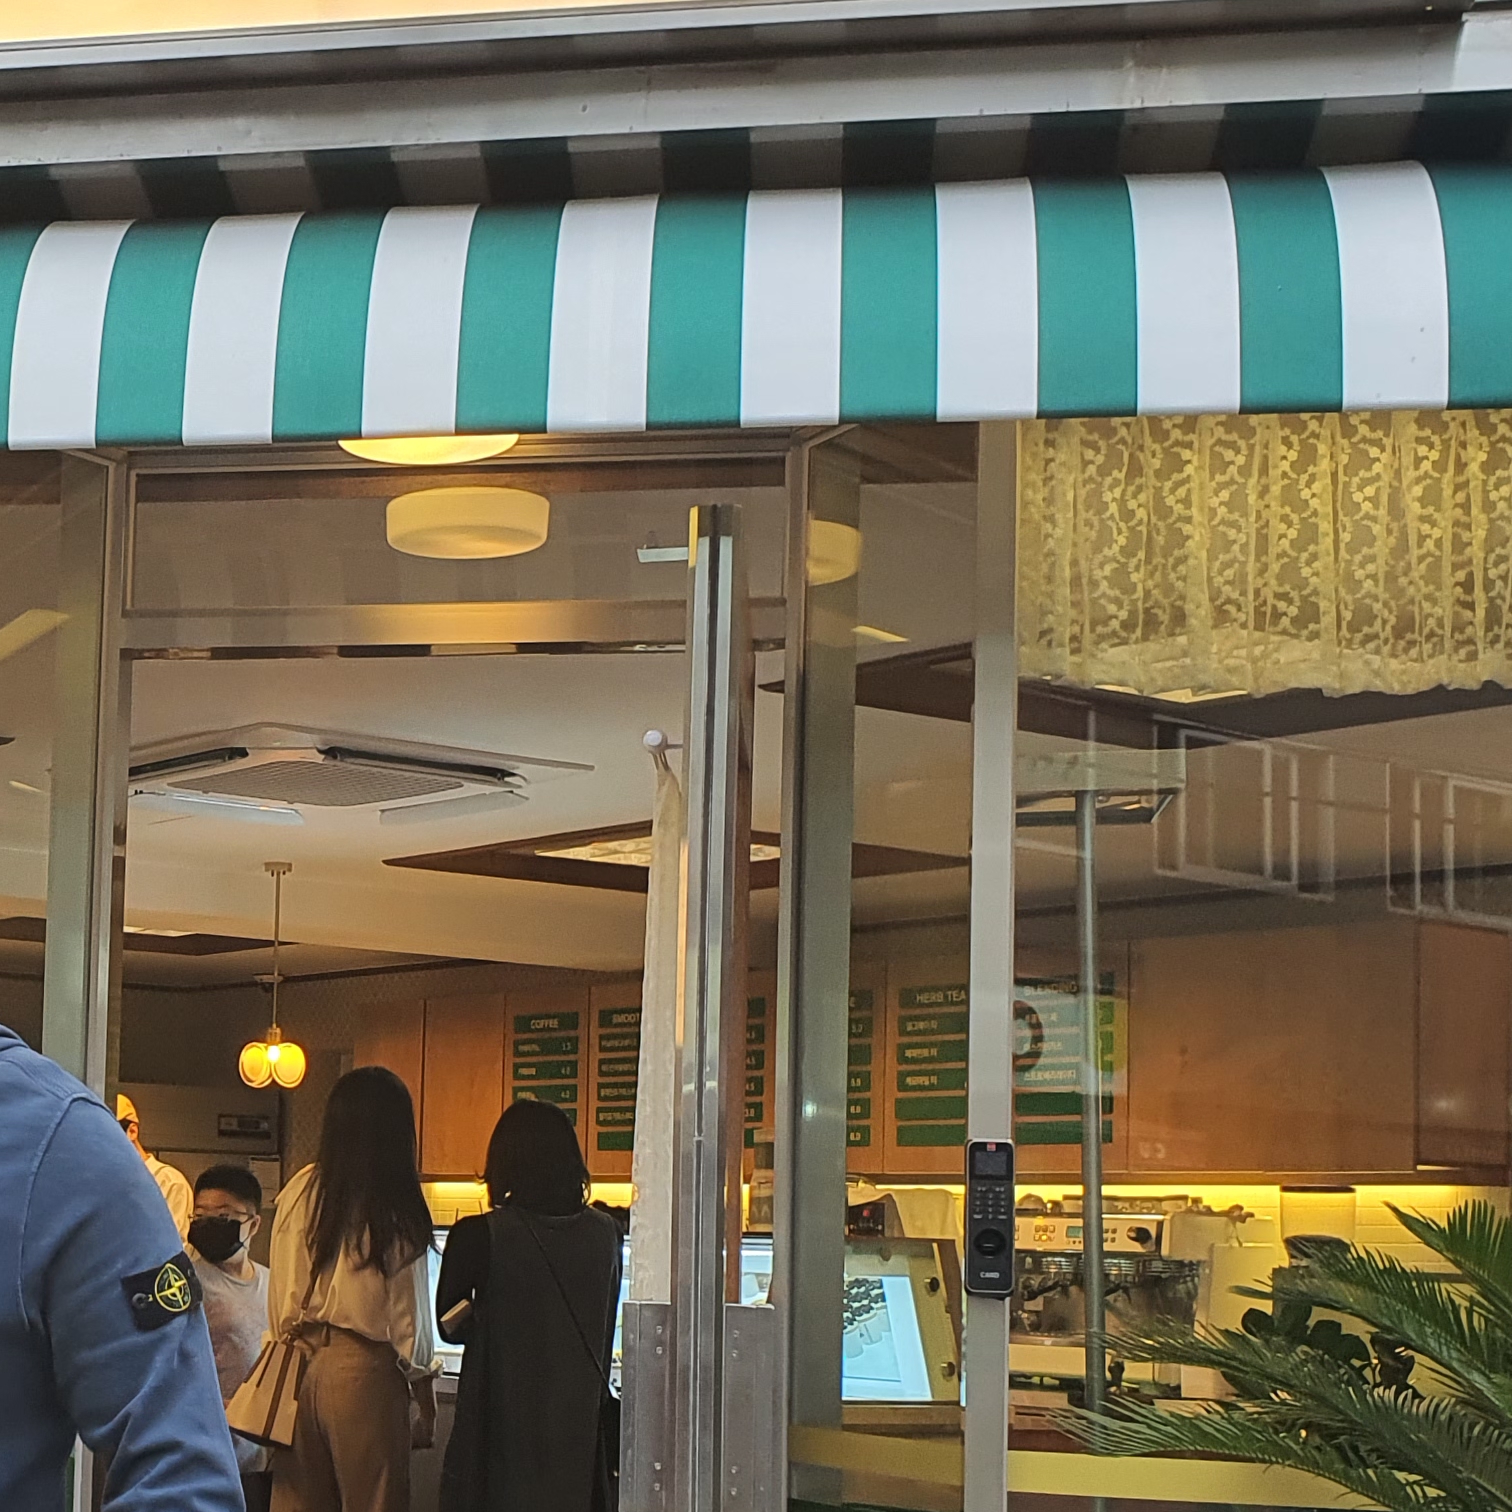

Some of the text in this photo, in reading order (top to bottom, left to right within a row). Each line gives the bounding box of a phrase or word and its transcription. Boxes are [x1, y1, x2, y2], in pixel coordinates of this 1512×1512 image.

[1024, 981, 1079, 996] BLENDING
[916, 990, 966, 1003] HERB TEA
[530, 1018, 559, 1029] COFFEE
